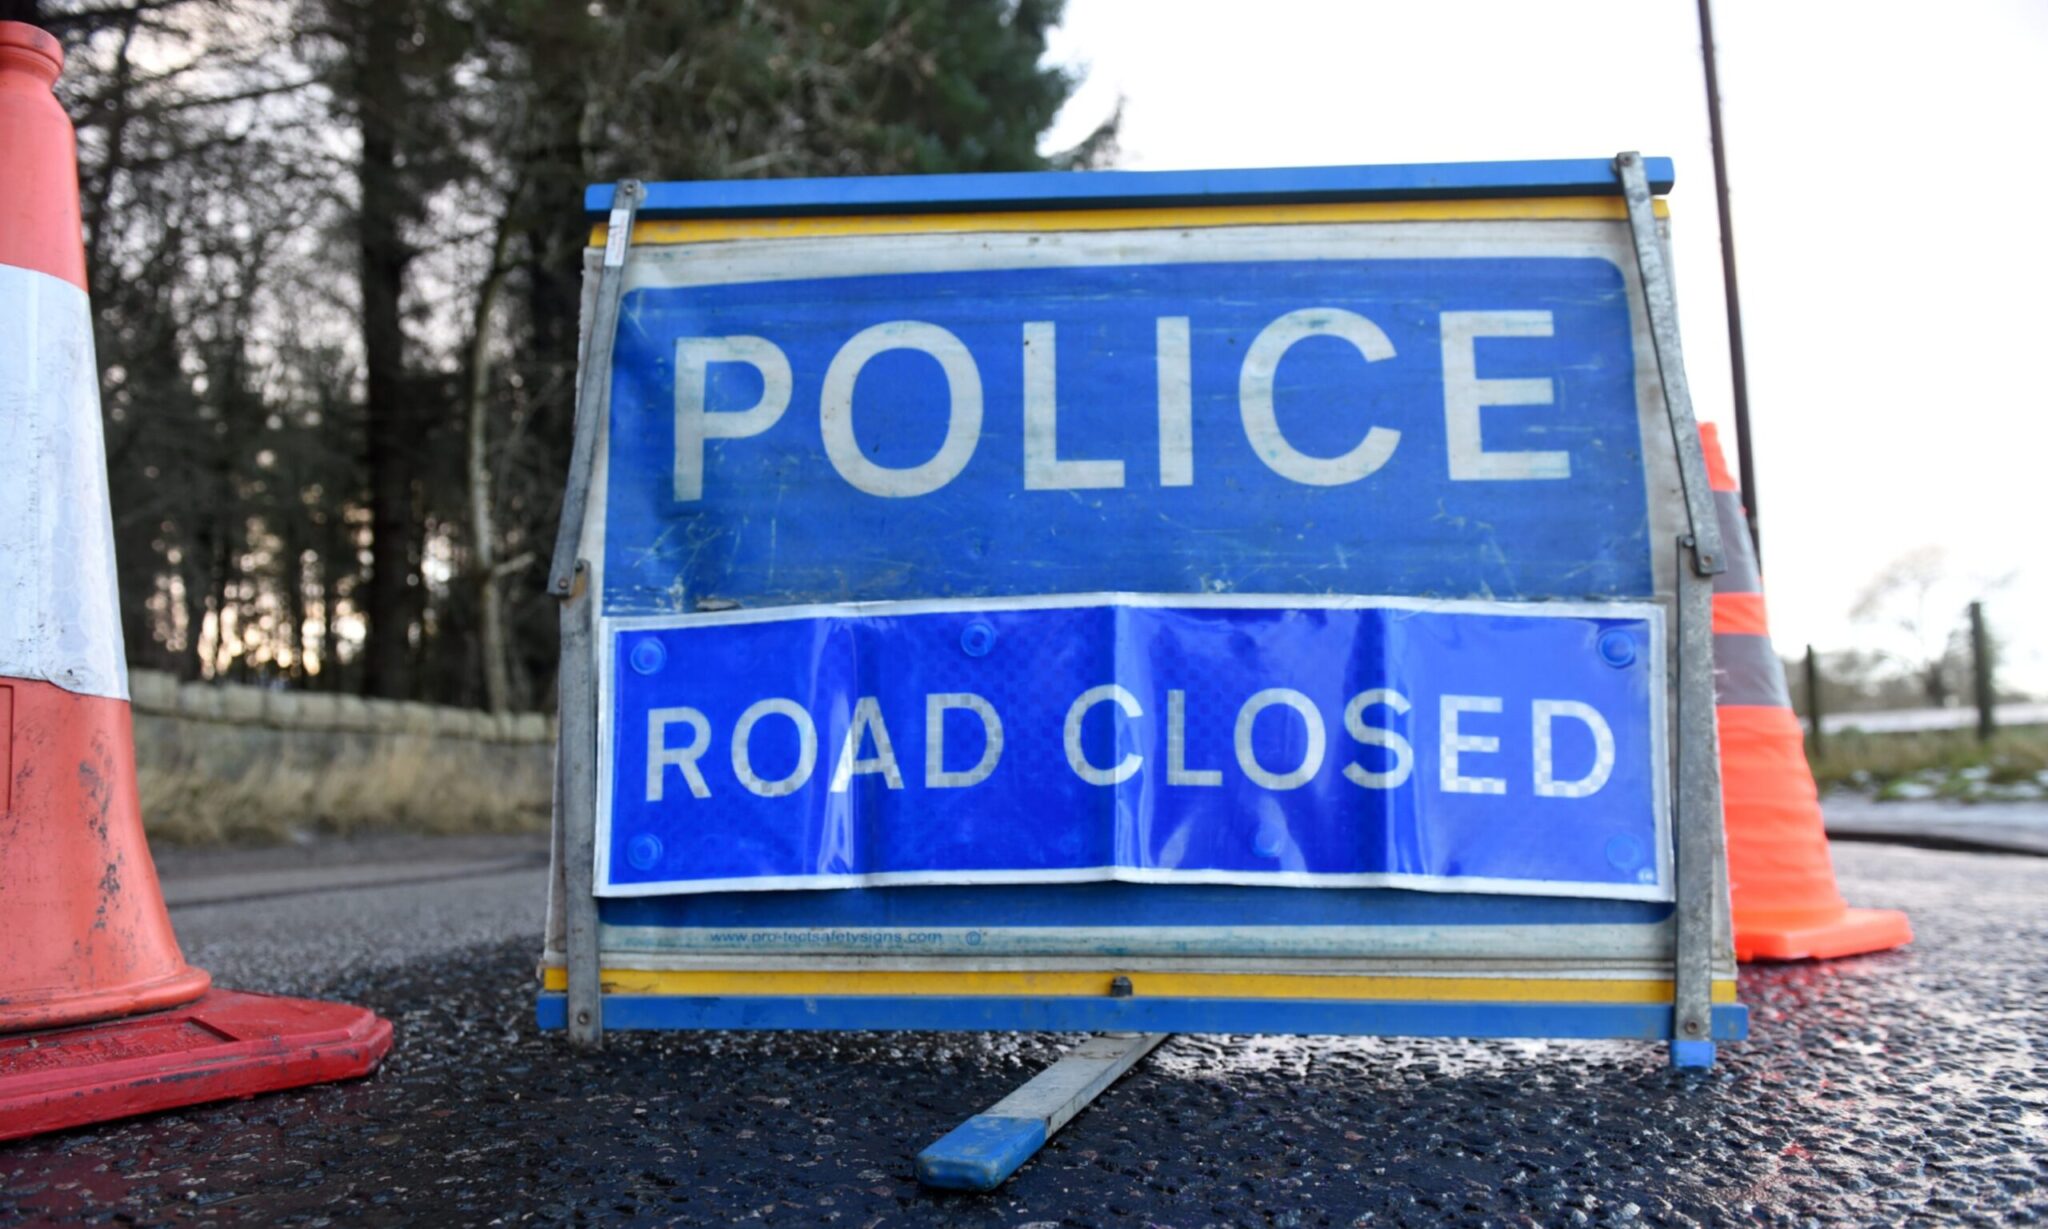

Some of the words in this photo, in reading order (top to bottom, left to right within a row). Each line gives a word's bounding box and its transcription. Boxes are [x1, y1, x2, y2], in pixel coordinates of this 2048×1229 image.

[672, 307, 1571, 503] POLICE
[645, 692, 1005, 803] ROAD
[1063, 683, 1617, 798] CLOSED
[709, 930, 943, 946] wwwpro-tectsafetysigns.com
